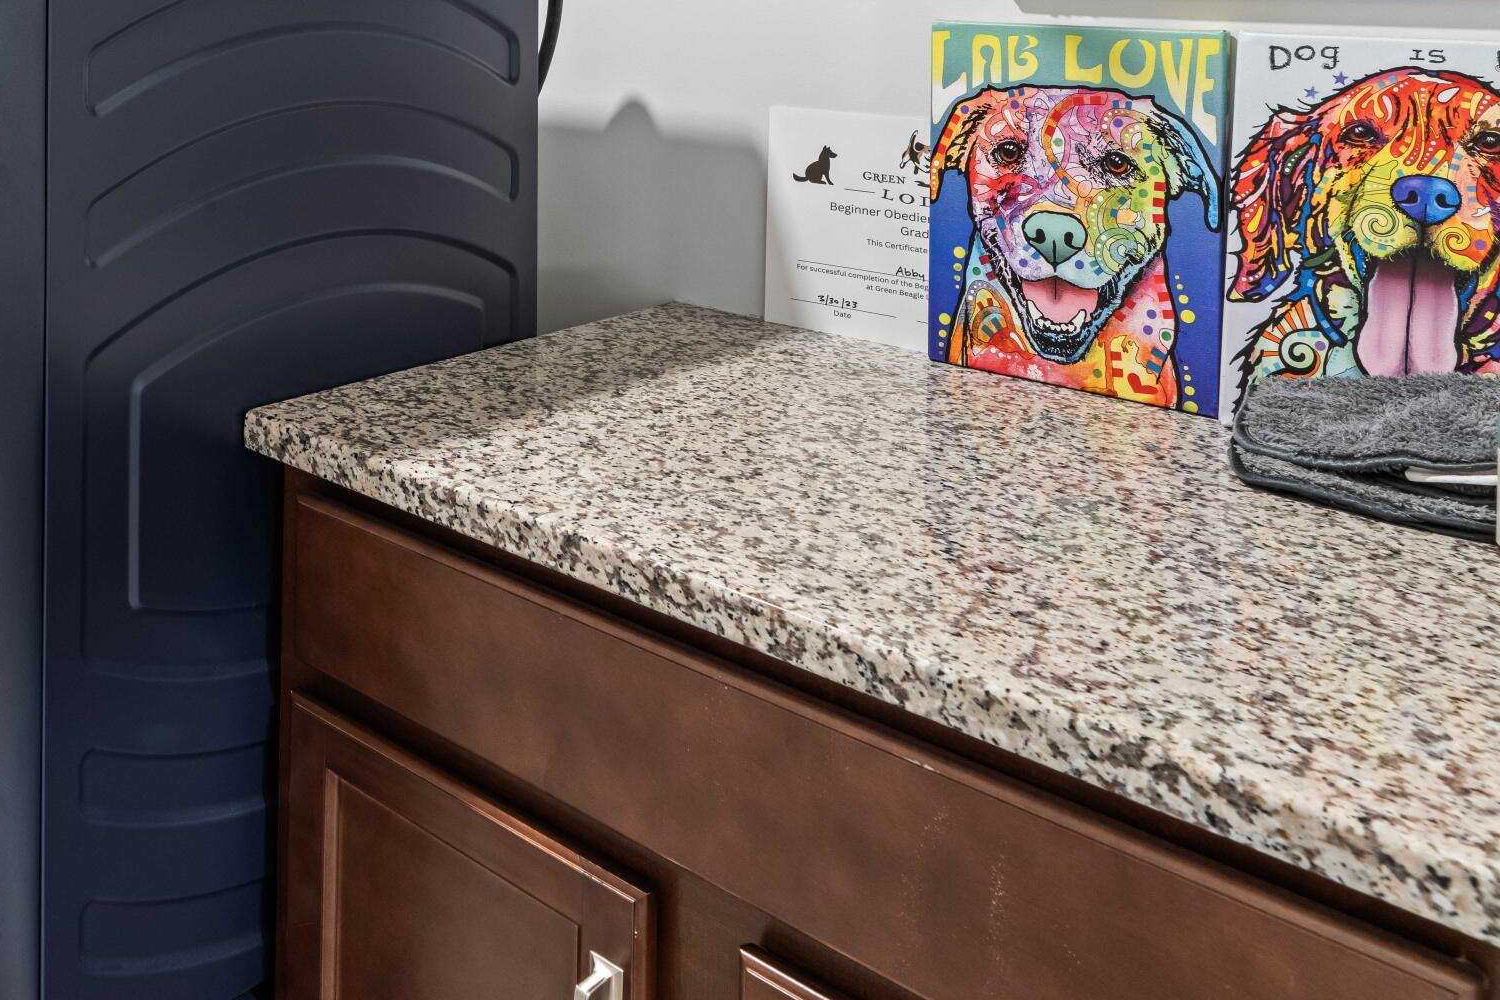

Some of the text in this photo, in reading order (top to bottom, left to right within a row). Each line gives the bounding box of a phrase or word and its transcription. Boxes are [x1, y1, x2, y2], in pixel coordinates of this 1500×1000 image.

[931, 30, 1220, 147] LAB LOVE
[862, 171, 906, 185] GREEN
[829, 201, 881, 217] Beginner
[866, 238, 928, 254] This Certificate
[796, 263, 809, 271] For
[809, 265, 847, 277] successful
[848, 272, 890, 285] completion
[900, 279, 913, 288] the
[895, 266, 925, 282] Abby
[875, 285, 897, 295] Green
[899, 289, 925, 300] Beagle
[833, 310, 852, 319] Date
